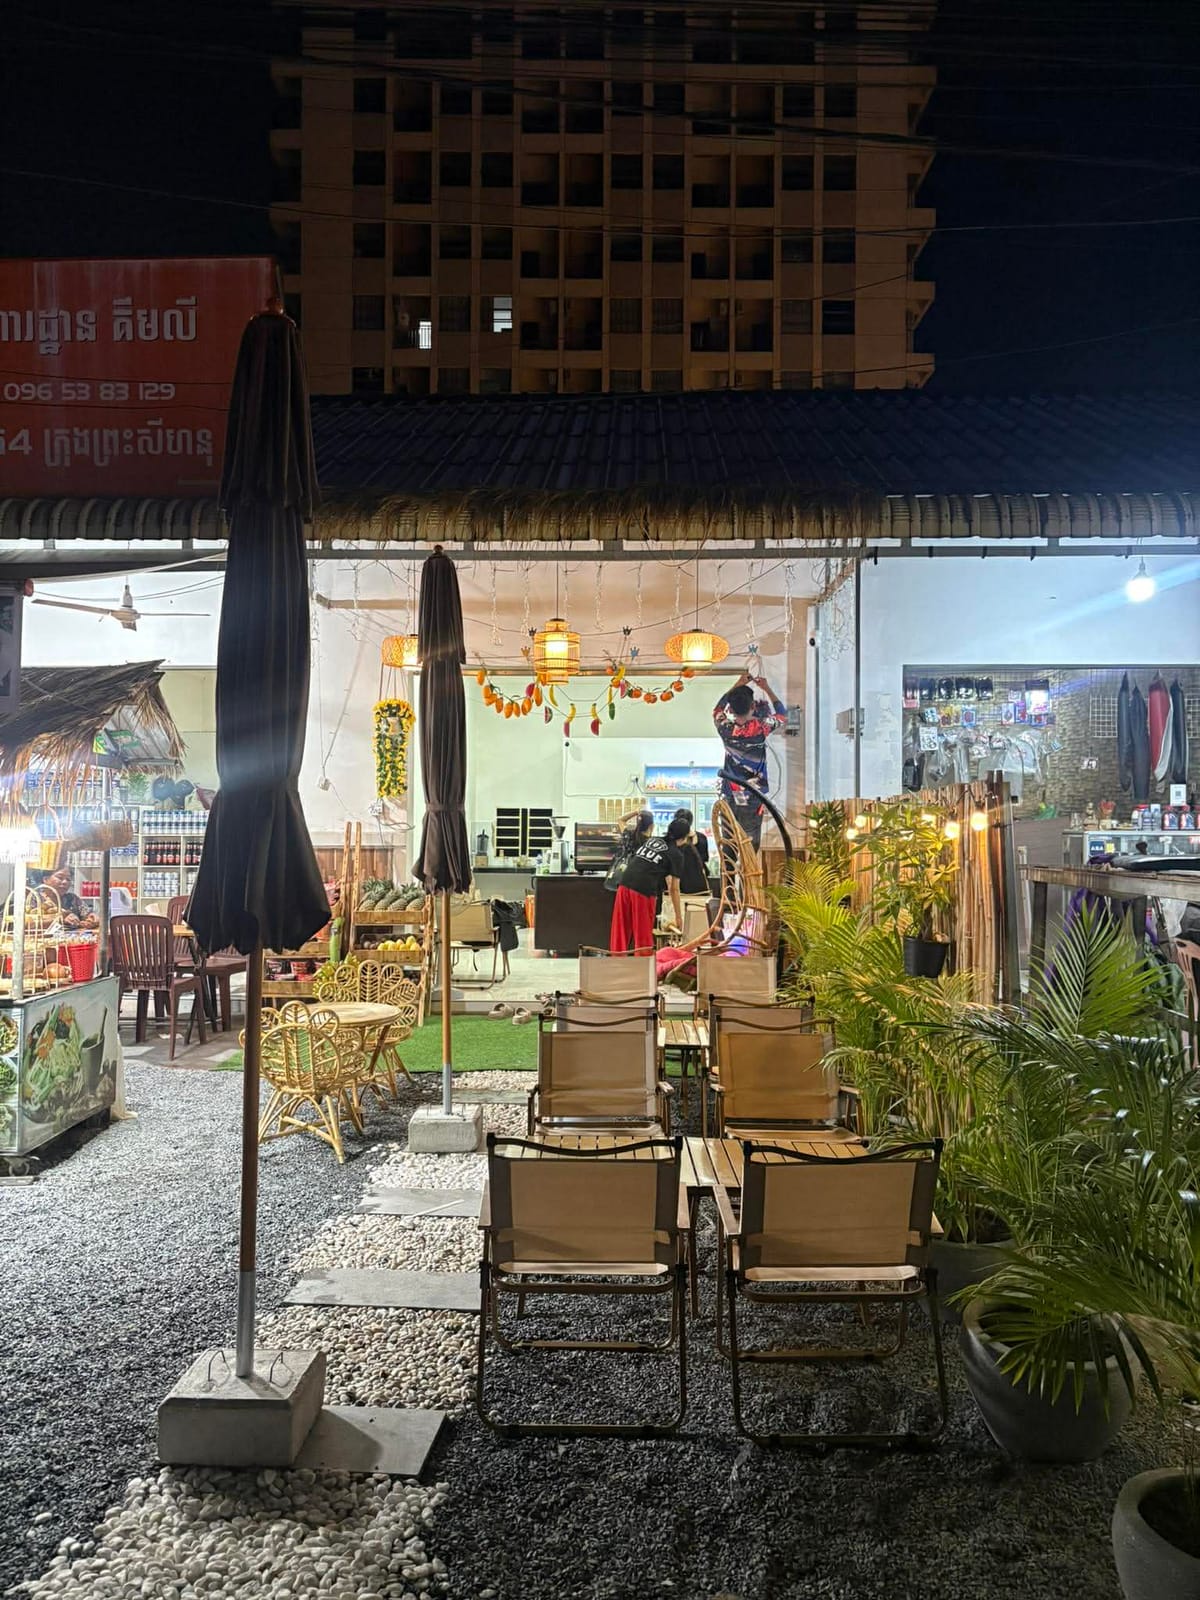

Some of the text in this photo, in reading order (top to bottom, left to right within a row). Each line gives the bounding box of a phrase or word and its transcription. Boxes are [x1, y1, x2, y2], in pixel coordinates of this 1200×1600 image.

[4, 382, 175, 401] 096 53 83 129
[0, 428, 33, 455] 4
